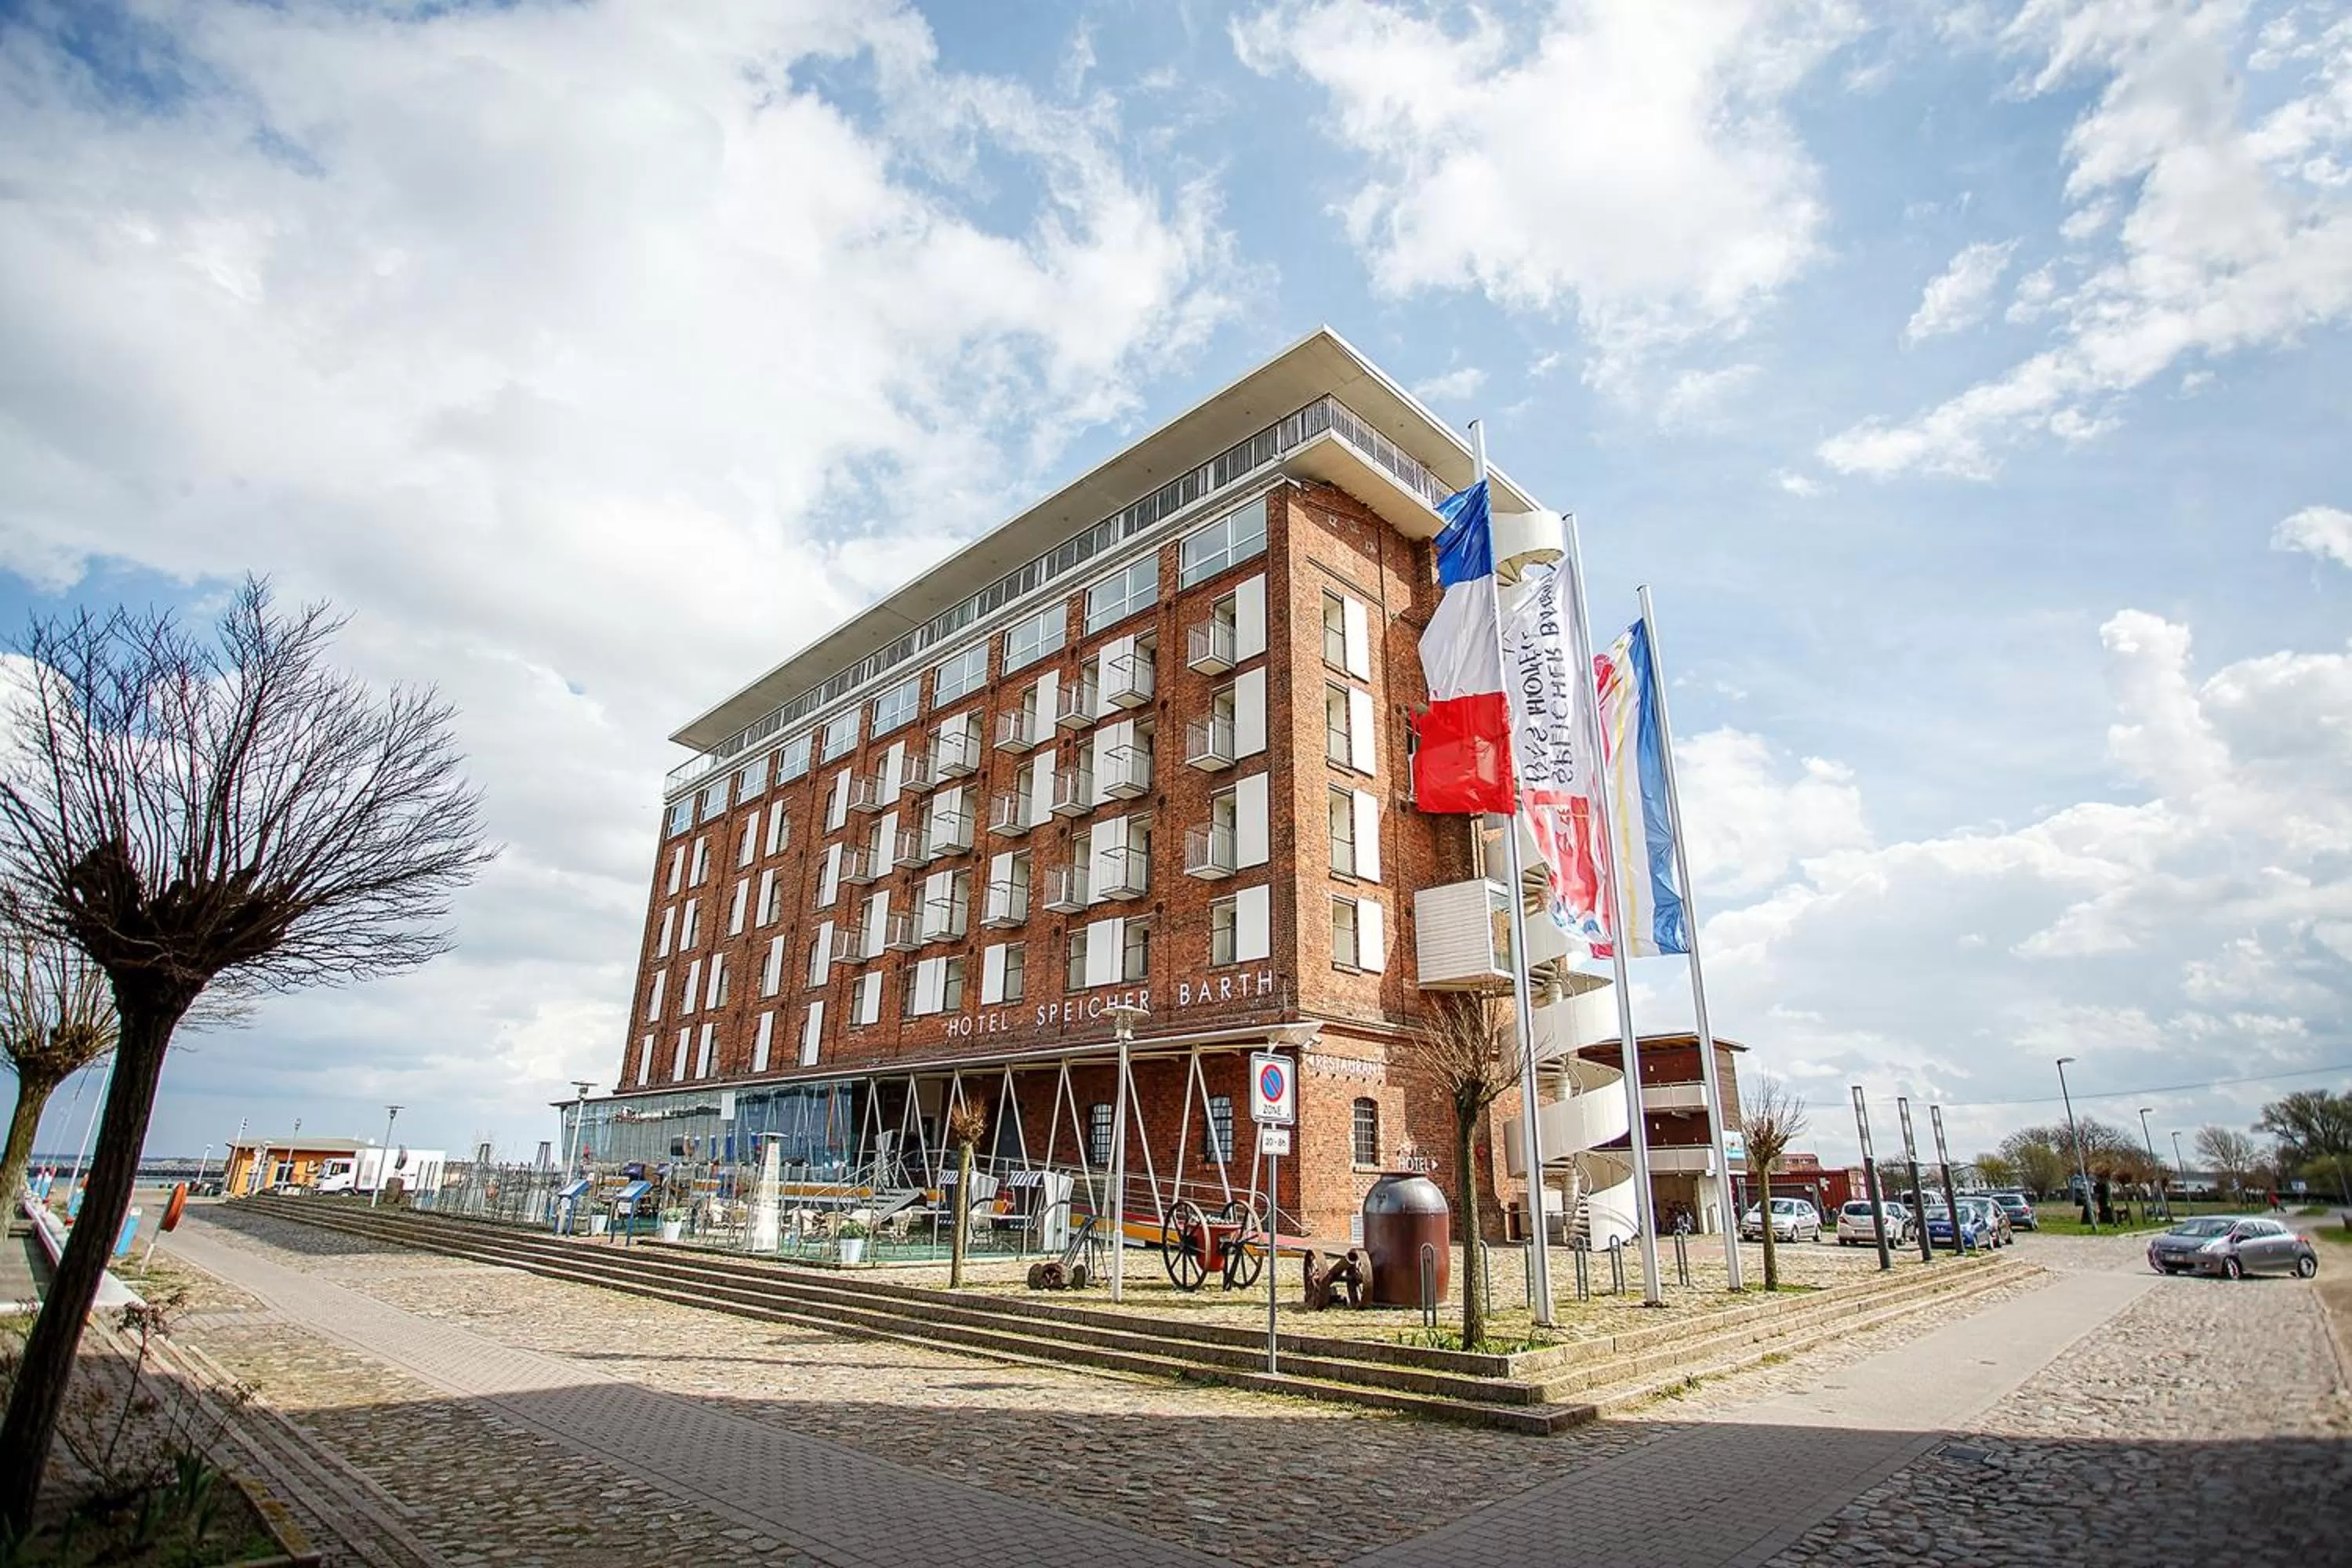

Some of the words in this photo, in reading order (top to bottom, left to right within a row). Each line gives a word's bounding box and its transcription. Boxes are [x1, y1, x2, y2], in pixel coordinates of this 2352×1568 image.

[947, 1012, 1009, 1037] HOTEL
[1036, 990, 1149, 1026] SPEICHER
[1179, 970, 1273, 1005] BARTH
[1316, 1054, 1384, 1076] RESTAURANT
[1263, 1104, 1282, 1116] ZONE
[1398, 1156, 1430, 1171] HOTEL
